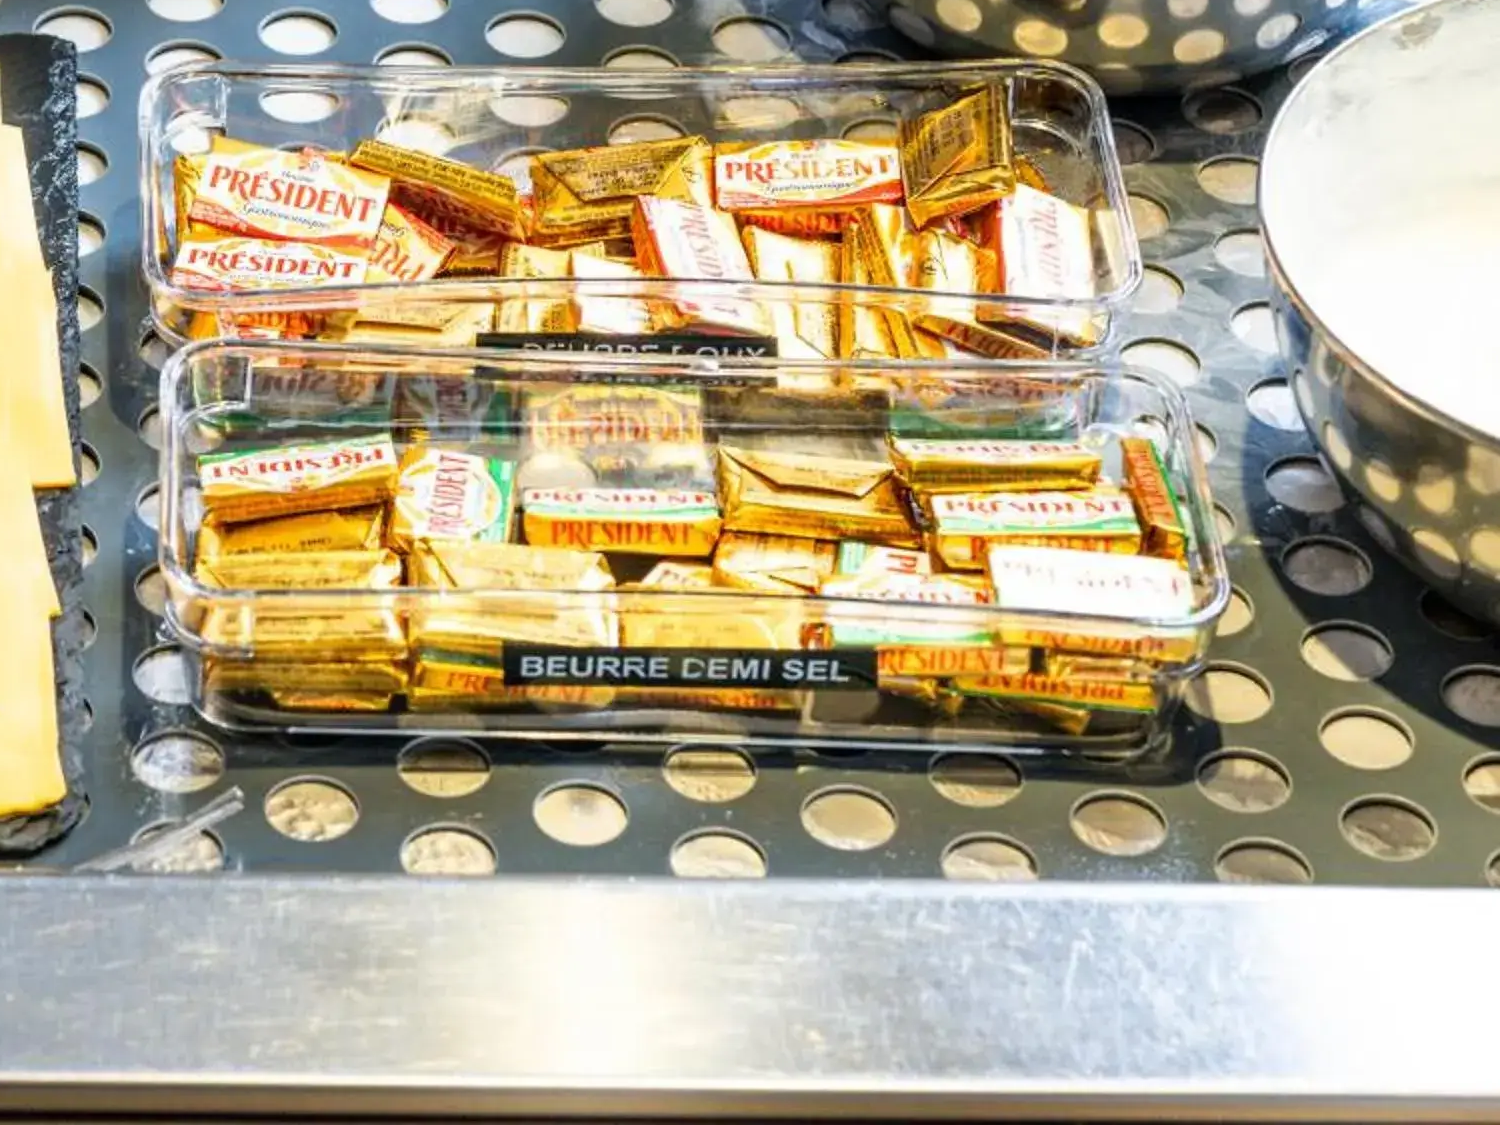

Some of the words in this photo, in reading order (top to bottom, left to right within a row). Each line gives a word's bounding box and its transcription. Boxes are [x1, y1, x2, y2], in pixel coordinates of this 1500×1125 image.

[209, 165, 376, 222] PRÉSIDENT
[187, 248, 358, 278] PRÉSIDENT
[521, 656, 668, 679] BEURRE
[681, 657, 771, 680] DEMI
[782, 659, 849, 682] SEL
